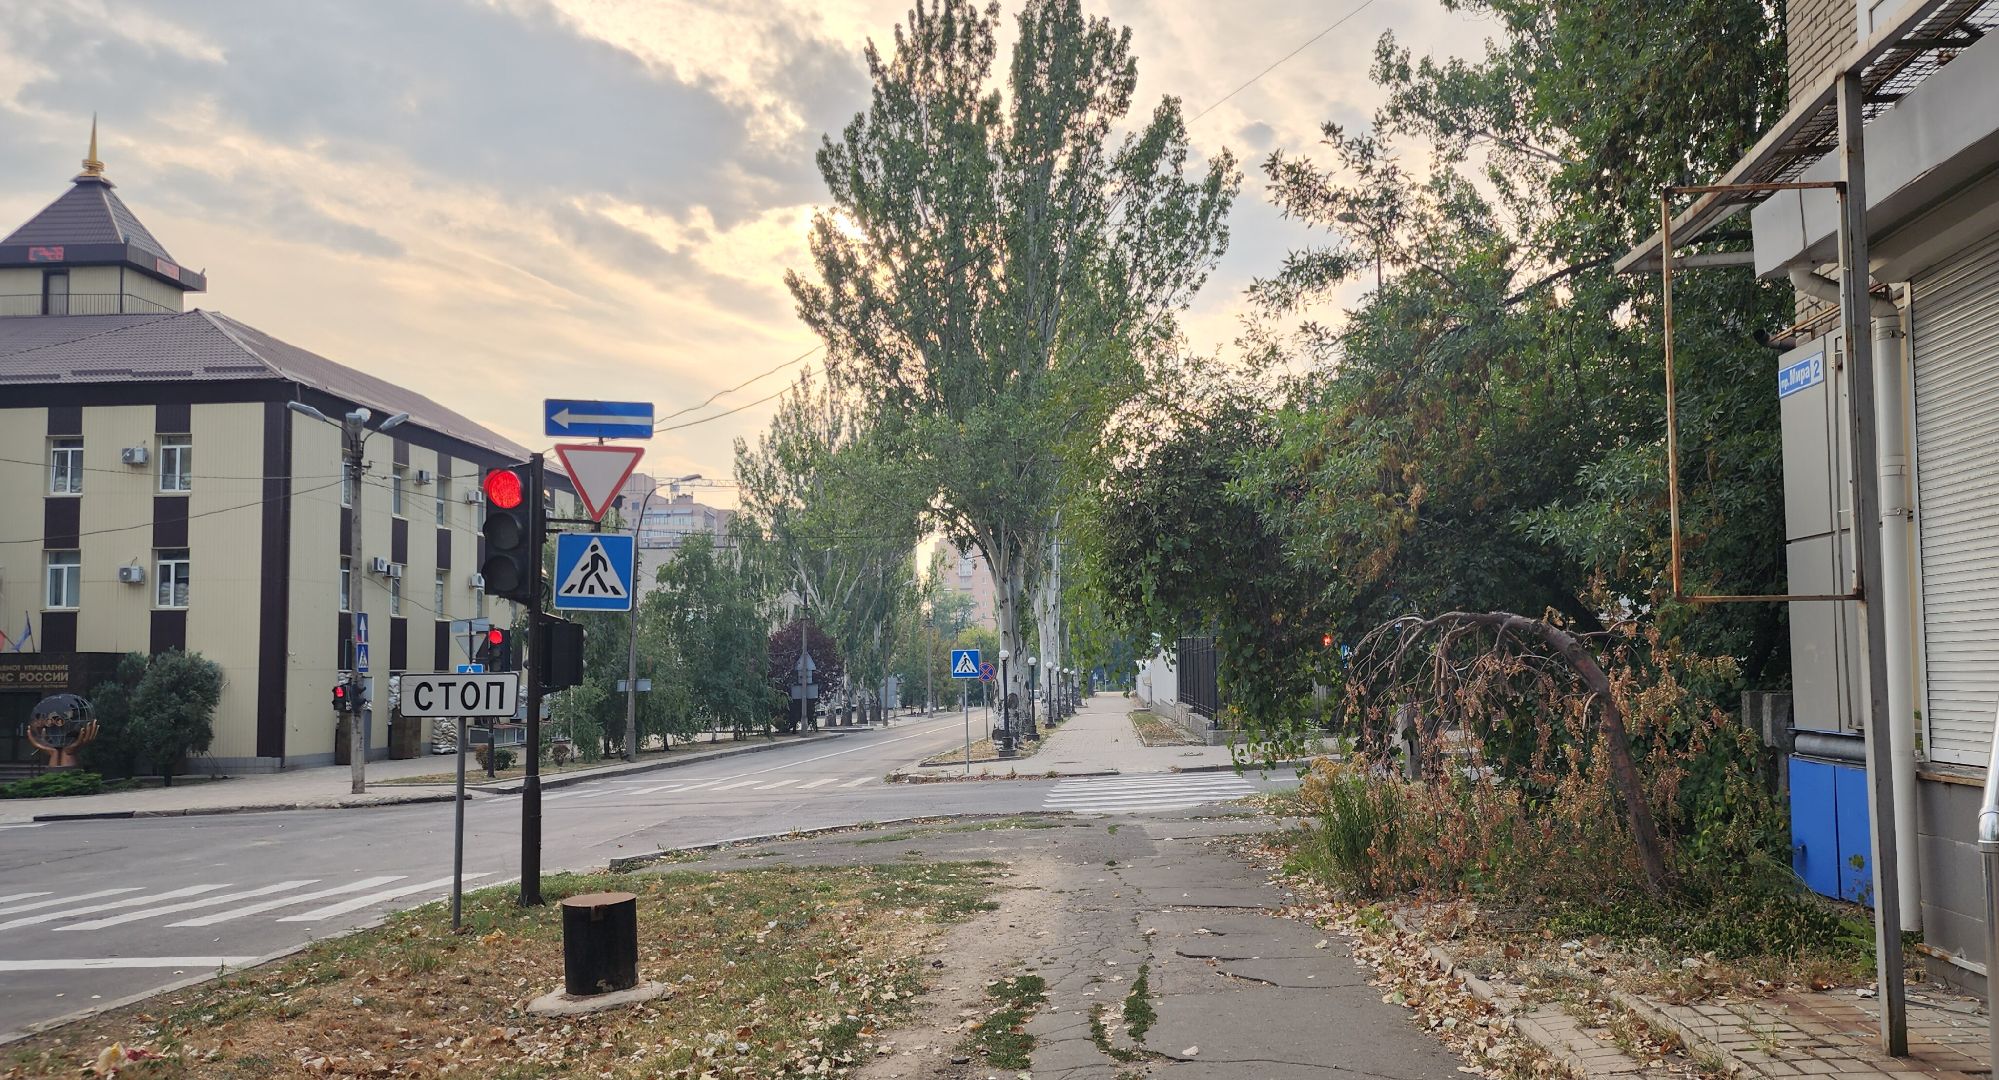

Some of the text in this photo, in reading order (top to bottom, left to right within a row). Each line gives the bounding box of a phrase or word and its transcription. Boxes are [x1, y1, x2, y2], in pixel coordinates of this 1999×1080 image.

[1790, 366, 1809, 385] Мира
[1814, 360, 1820, 377] 2
[19, 672, 69, 682] РОССИИ
[414, 681, 505, 711] СТОП
